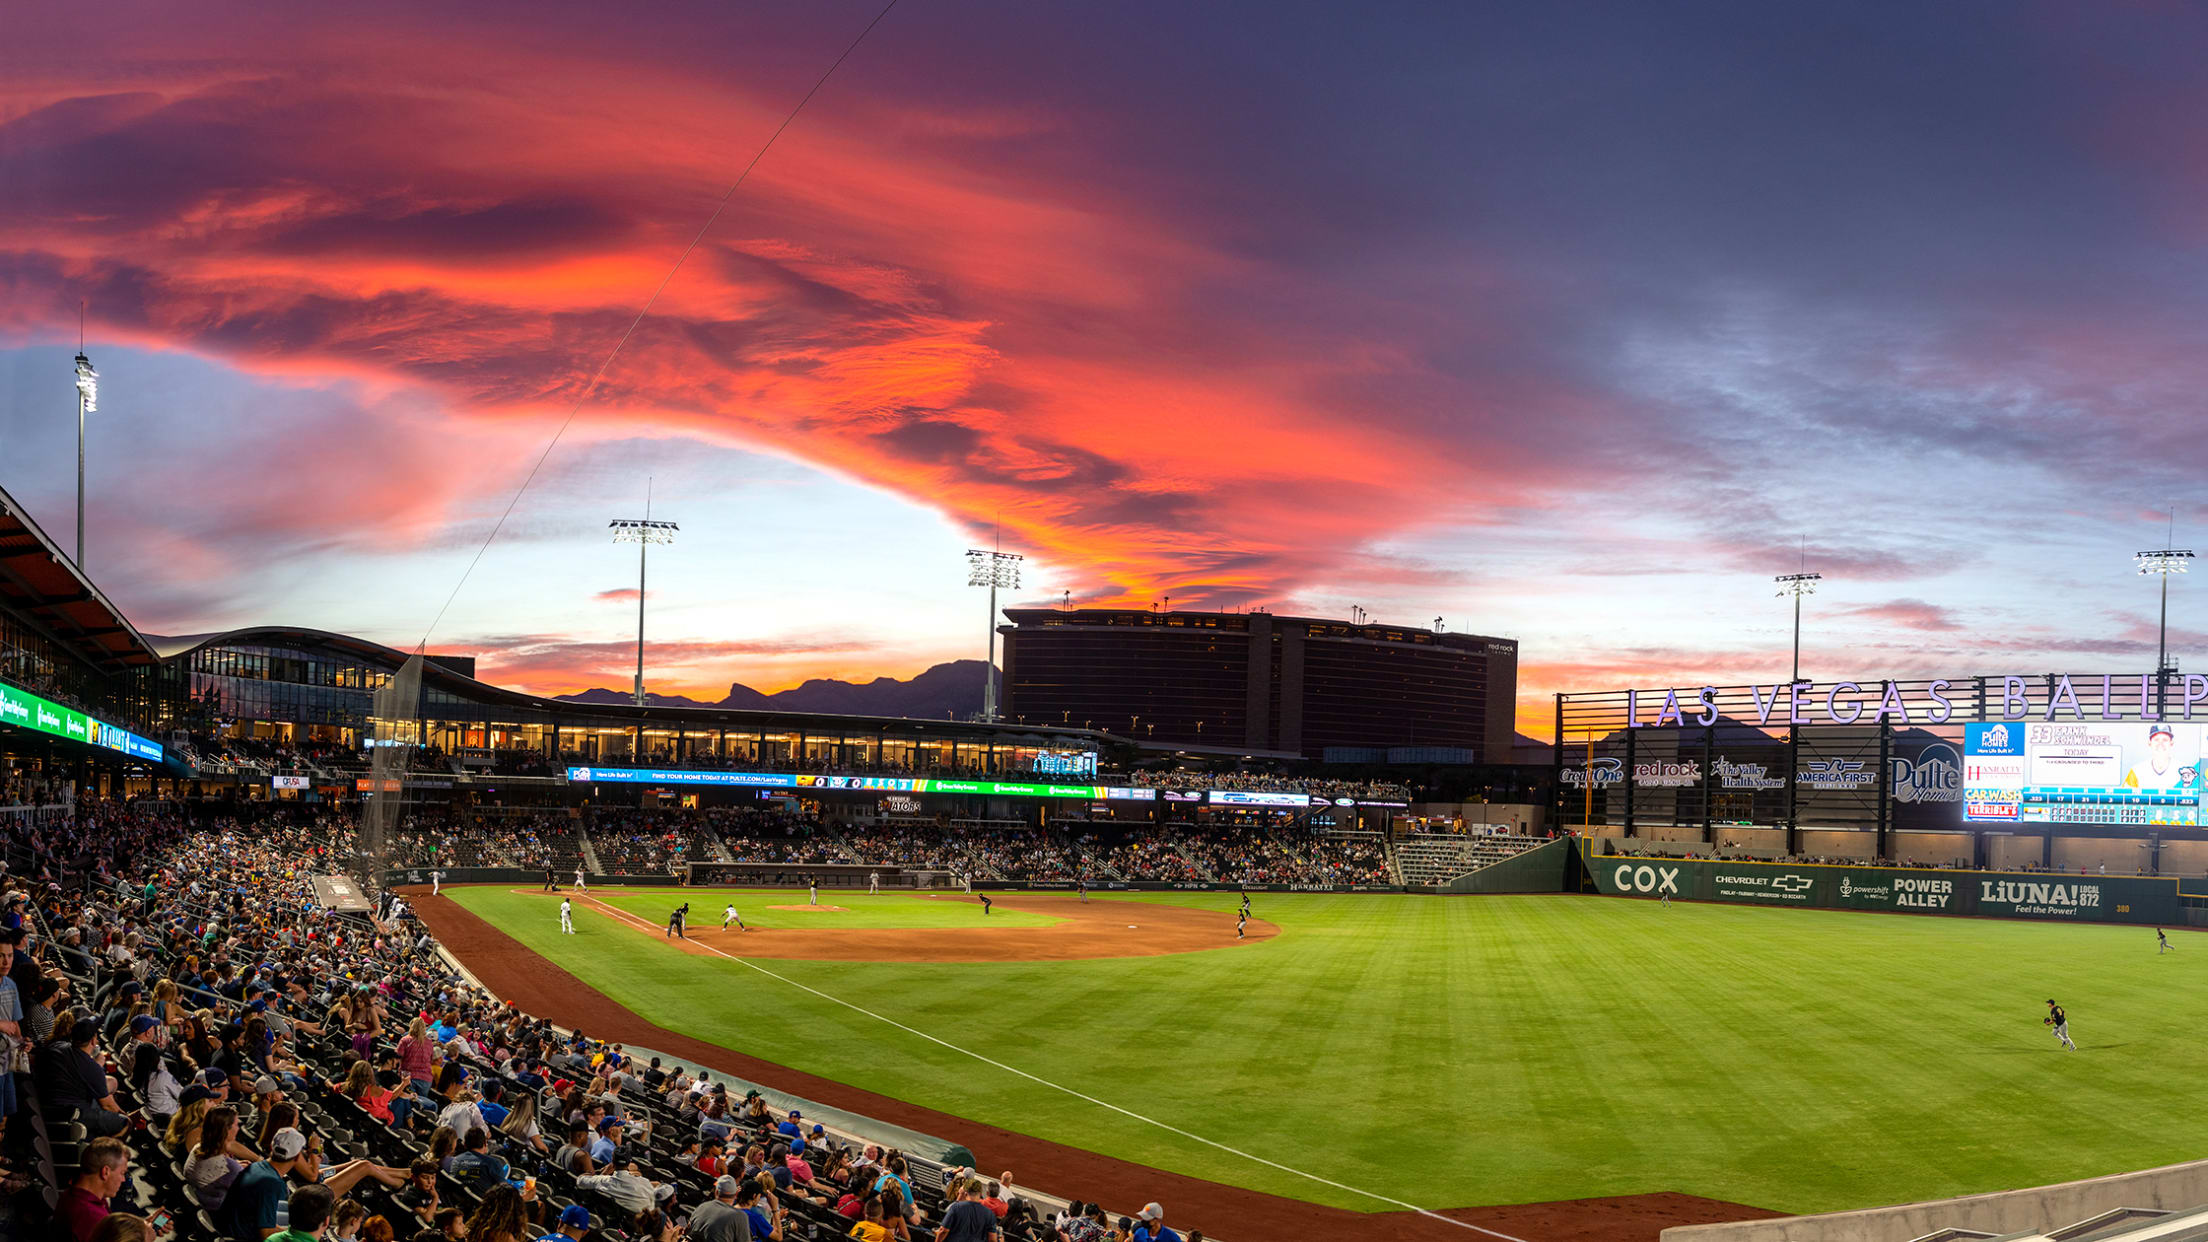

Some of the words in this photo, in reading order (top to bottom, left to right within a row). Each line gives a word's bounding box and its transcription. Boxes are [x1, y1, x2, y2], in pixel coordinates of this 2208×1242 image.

[1629, 686, 1719, 728] LAS
[1751, 679, 1952, 725] VEGAS
[1982, 728, 2008, 740] Pulte
[2030, 725, 2052, 744] 33
[2054, 726, 2088, 736] FRANK
[1633, 760, 1660, 776] red
[1663, 760, 1698, 776] rock
[1723, 764, 1737, 776] The
[1738, 764, 1766, 776] Valley
[1722, 776, 1754, 788] Health
[1754, 777, 1785, 790] System
[1796, 773, 1841, 782] AMERICA
[1843, 773, 1875, 783] FIRST
[1888, 758, 1960, 797] Pulte
[1966, 790, 1990, 802] CAR
[1990, 790, 2022, 802] WASH
[1614, 864, 1679, 894] COX
[1716, 876, 1768, 886] CHEVROLET
[1894, 878, 1952, 894] POWER
[1853, 886, 1888, 895] powershift
[1980, 880, 2078, 906] LiUNA!
[2080, 885, 2100, 894] LOCAL
[1896, 893, 1949, 908] ALLEY
[2080, 894, 2099, 907] 872
[2015, 904, 2032, 913] Feel
[2033, 905, 2046, 914] the
[2048, 906, 2076, 915] Power!
